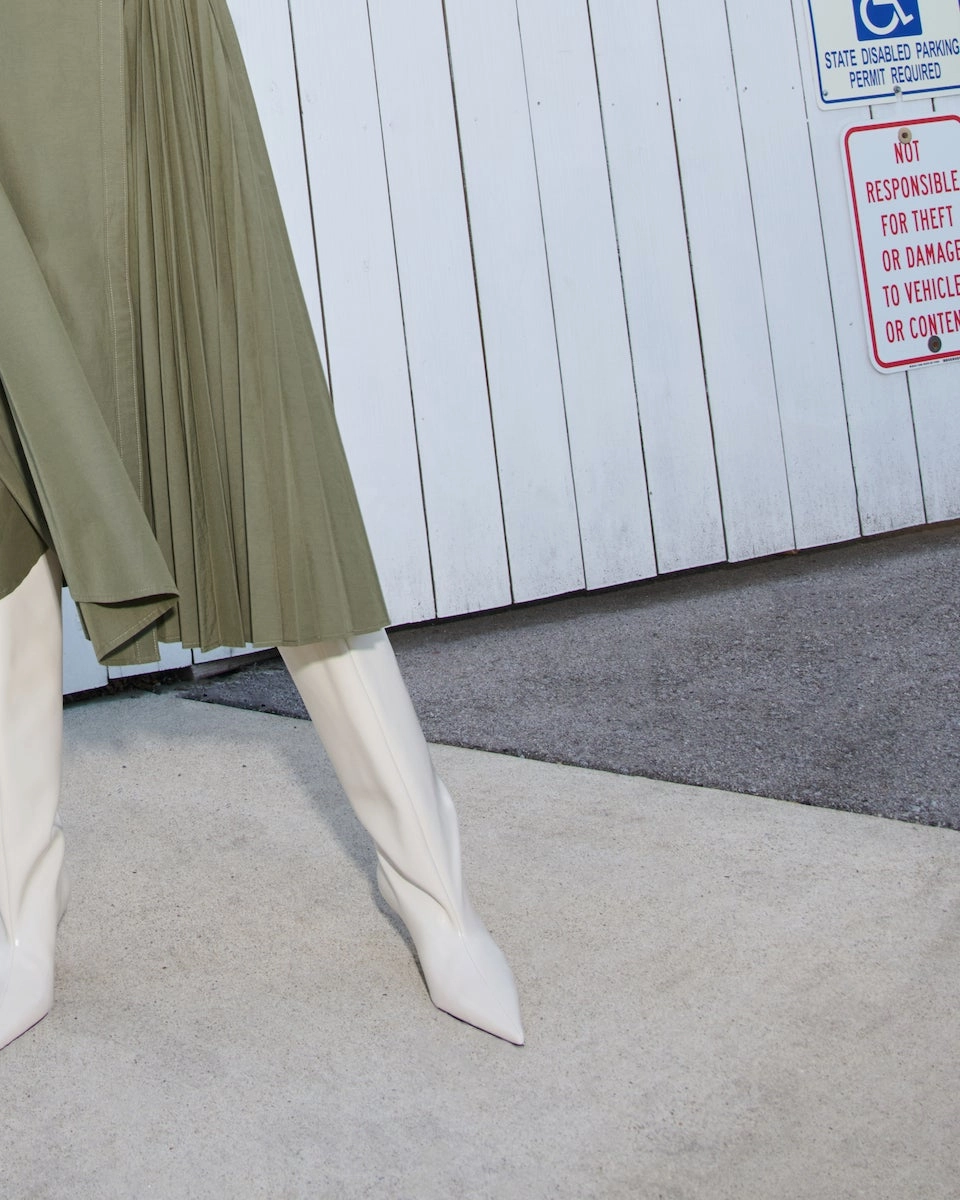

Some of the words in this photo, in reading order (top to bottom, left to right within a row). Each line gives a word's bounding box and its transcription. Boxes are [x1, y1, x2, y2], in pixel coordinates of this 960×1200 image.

[825, 49, 857, 69] STATE
[861, 43, 911, 65] DISABLED
[915, 38, 960, 59] PARKING
[849, 69, 886, 89] PERMIT
[891, 62, 942, 83] REQUIRED
[894, 140, 920, 164] NOT
[866, 169, 960, 203] RESPONSIBLE
[881, 212, 908, 237] FOR
[912, 205, 953, 232] THEFT
[882, 248, 901, 272] OR
[905, 239, 960, 268] DAMAGE
[882, 284, 900, 308] TO
[904, 274, 960, 304] VEHICLE
[885, 319, 905, 343] OR
